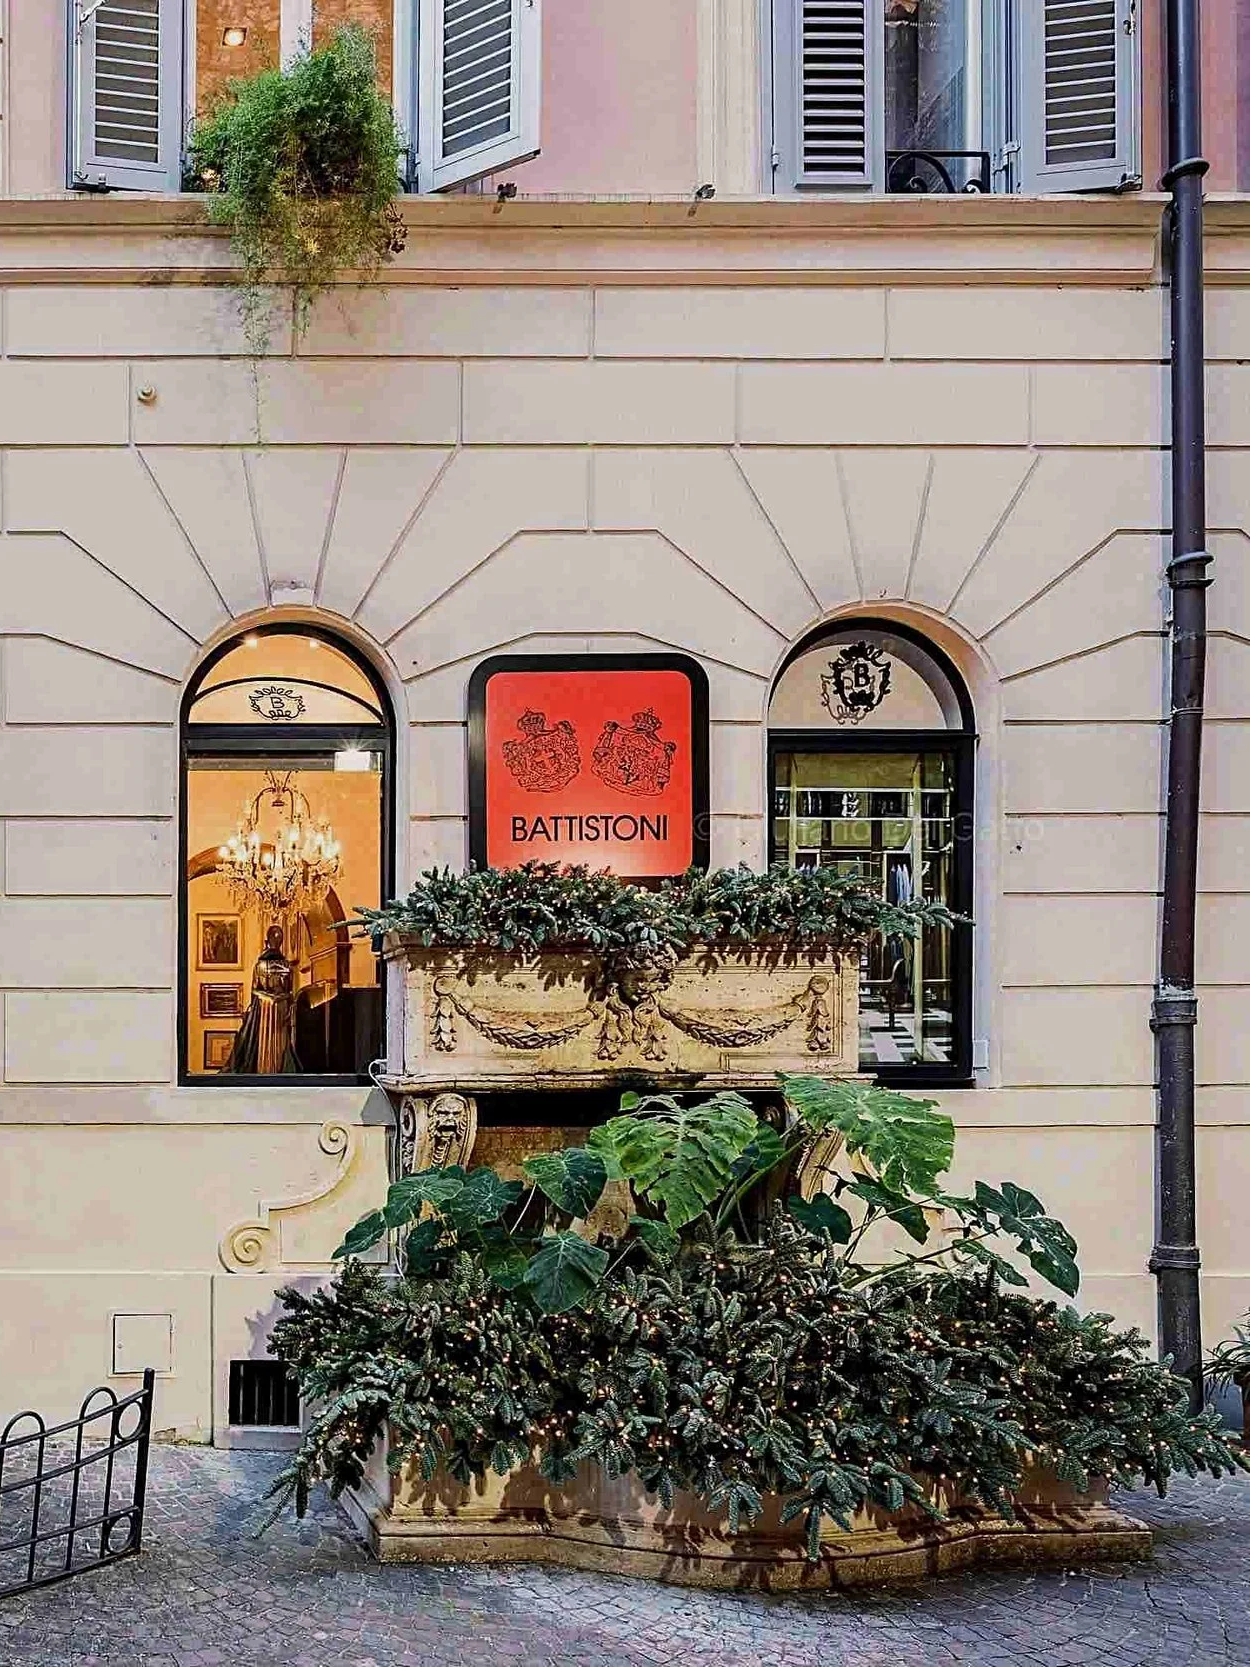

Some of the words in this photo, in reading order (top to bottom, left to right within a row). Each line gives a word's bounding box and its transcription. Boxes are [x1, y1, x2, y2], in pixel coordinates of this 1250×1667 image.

[853, 662, 870, 688] B
[270, 696, 286, 709] B
[511, 814, 669, 842] BATTISTONI
